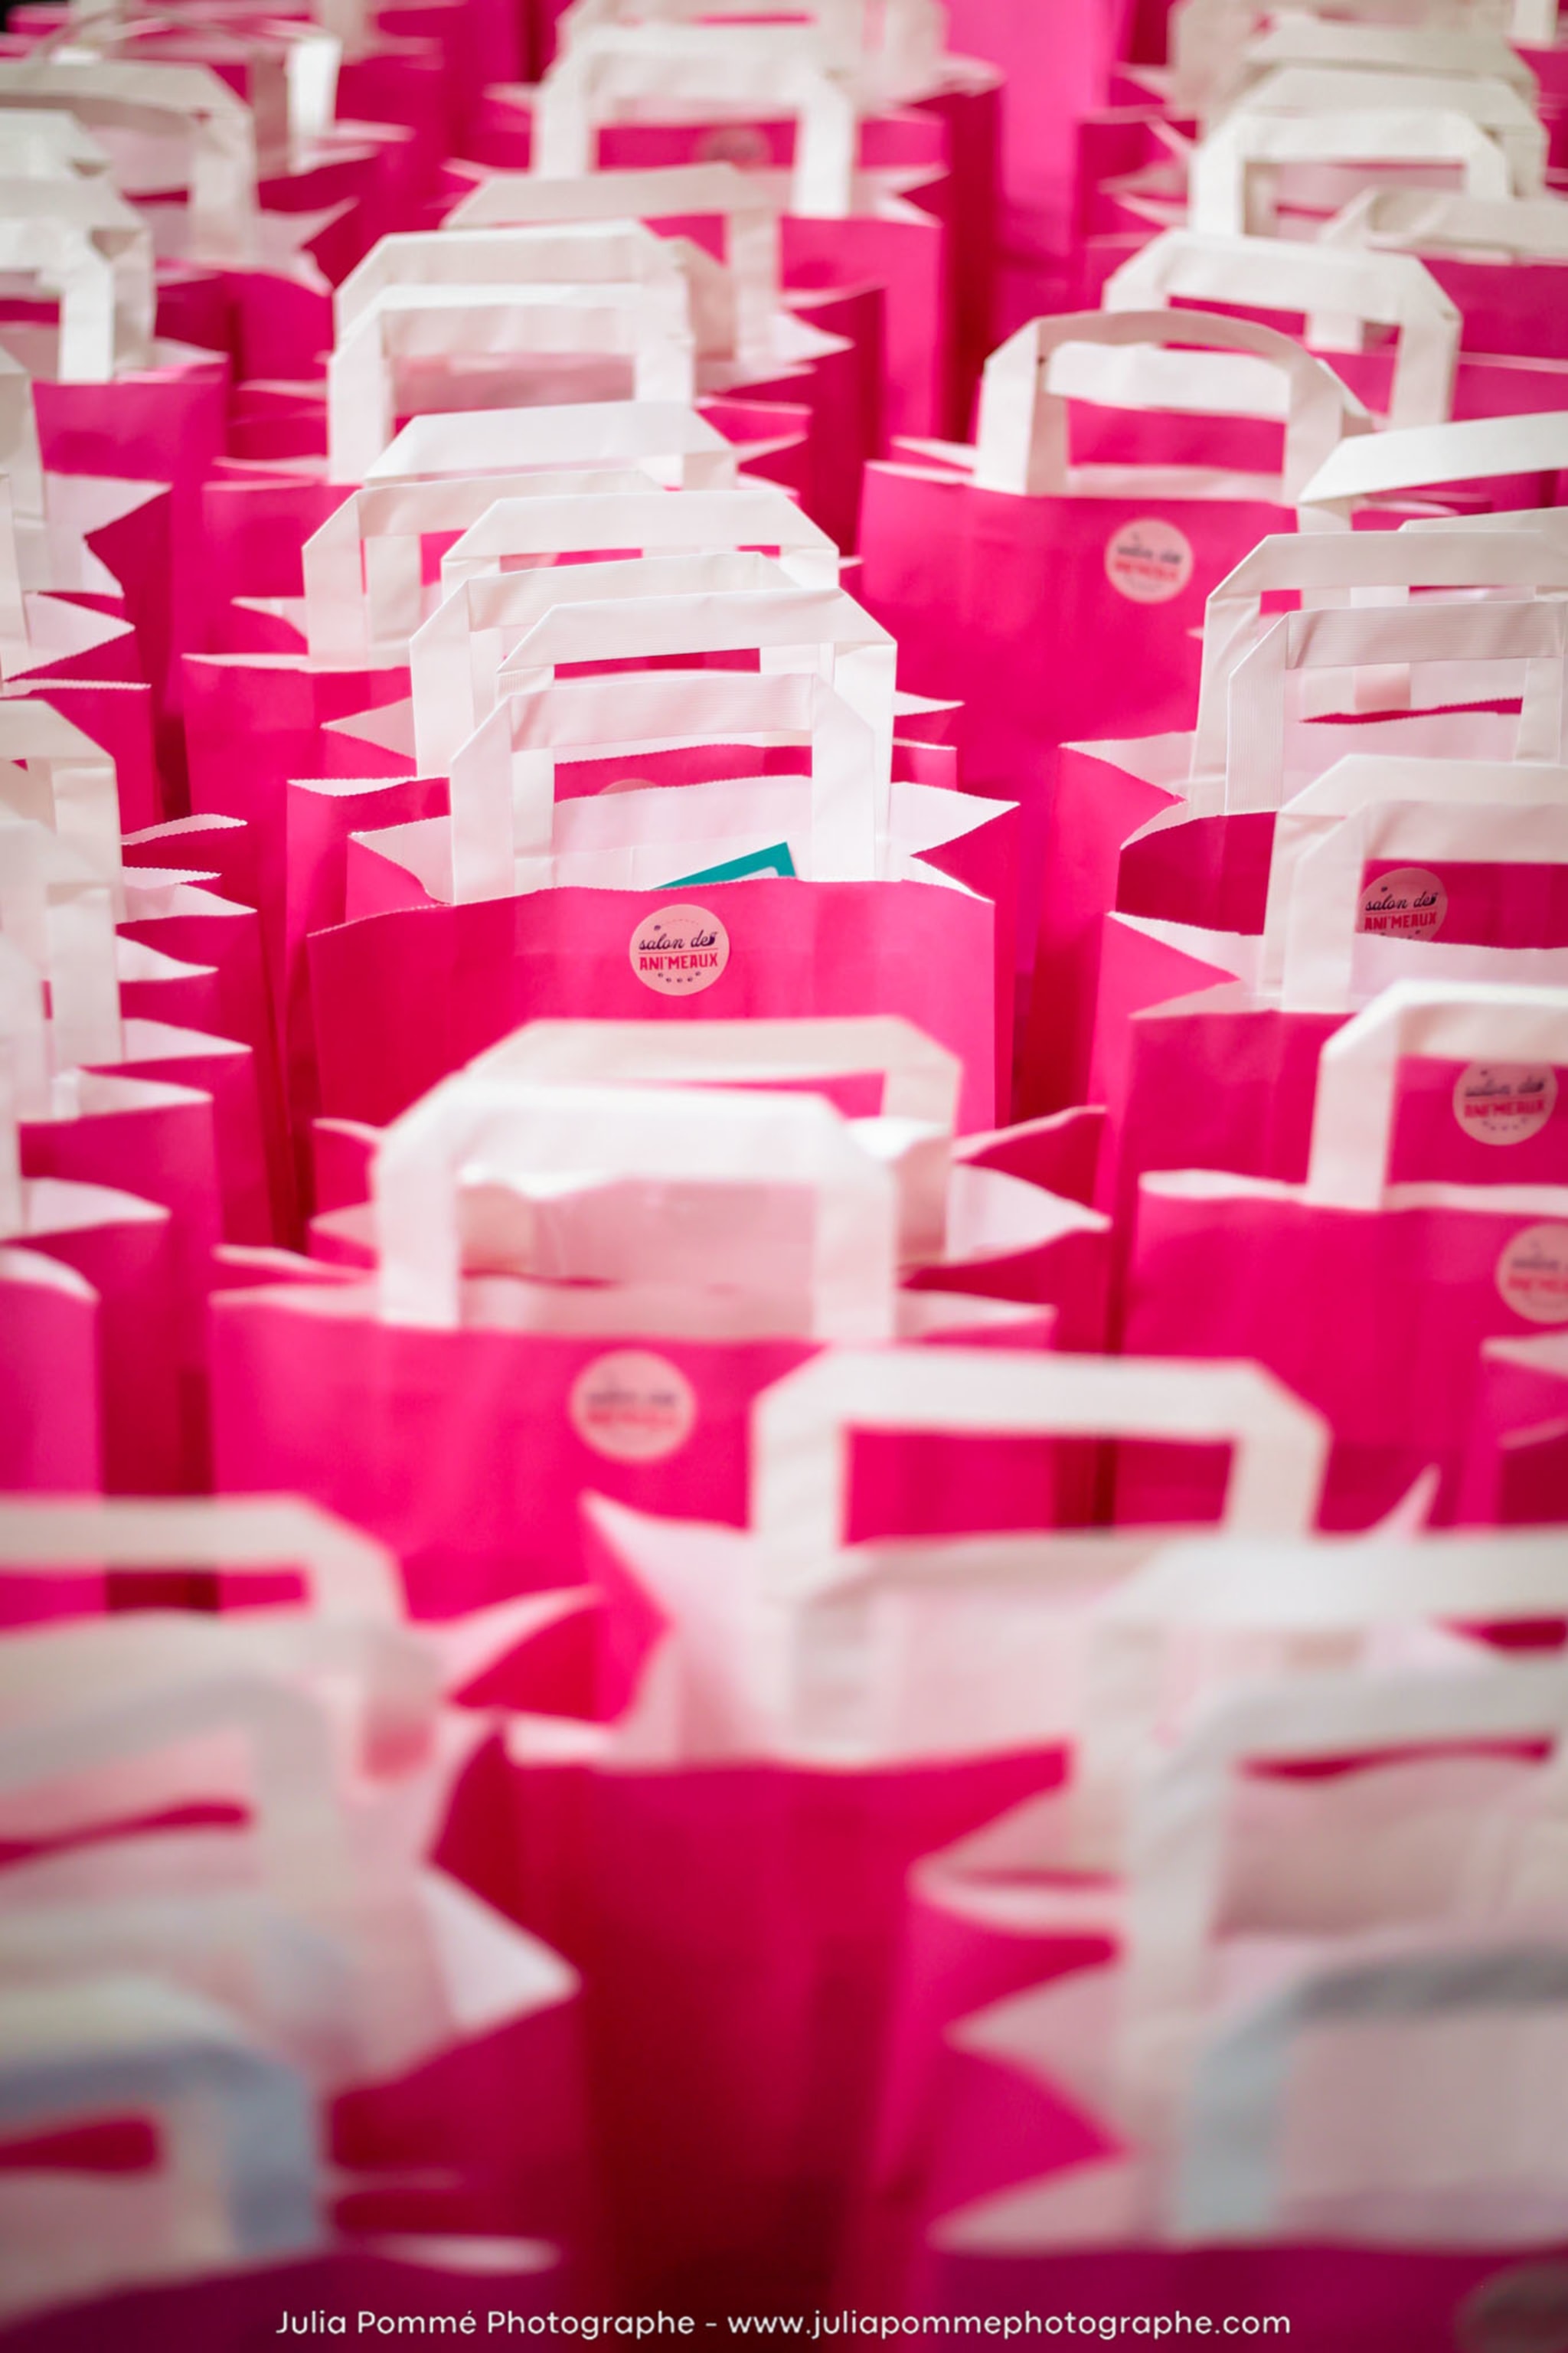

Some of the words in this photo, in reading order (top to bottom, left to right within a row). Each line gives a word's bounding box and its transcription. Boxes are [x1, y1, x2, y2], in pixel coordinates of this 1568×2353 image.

[1365, 894, 1407, 911] salon
[639, 933, 684, 950] salon
[690, 929, 718, 948] des
[639, 953, 718, 971] ANI'MEAUX
